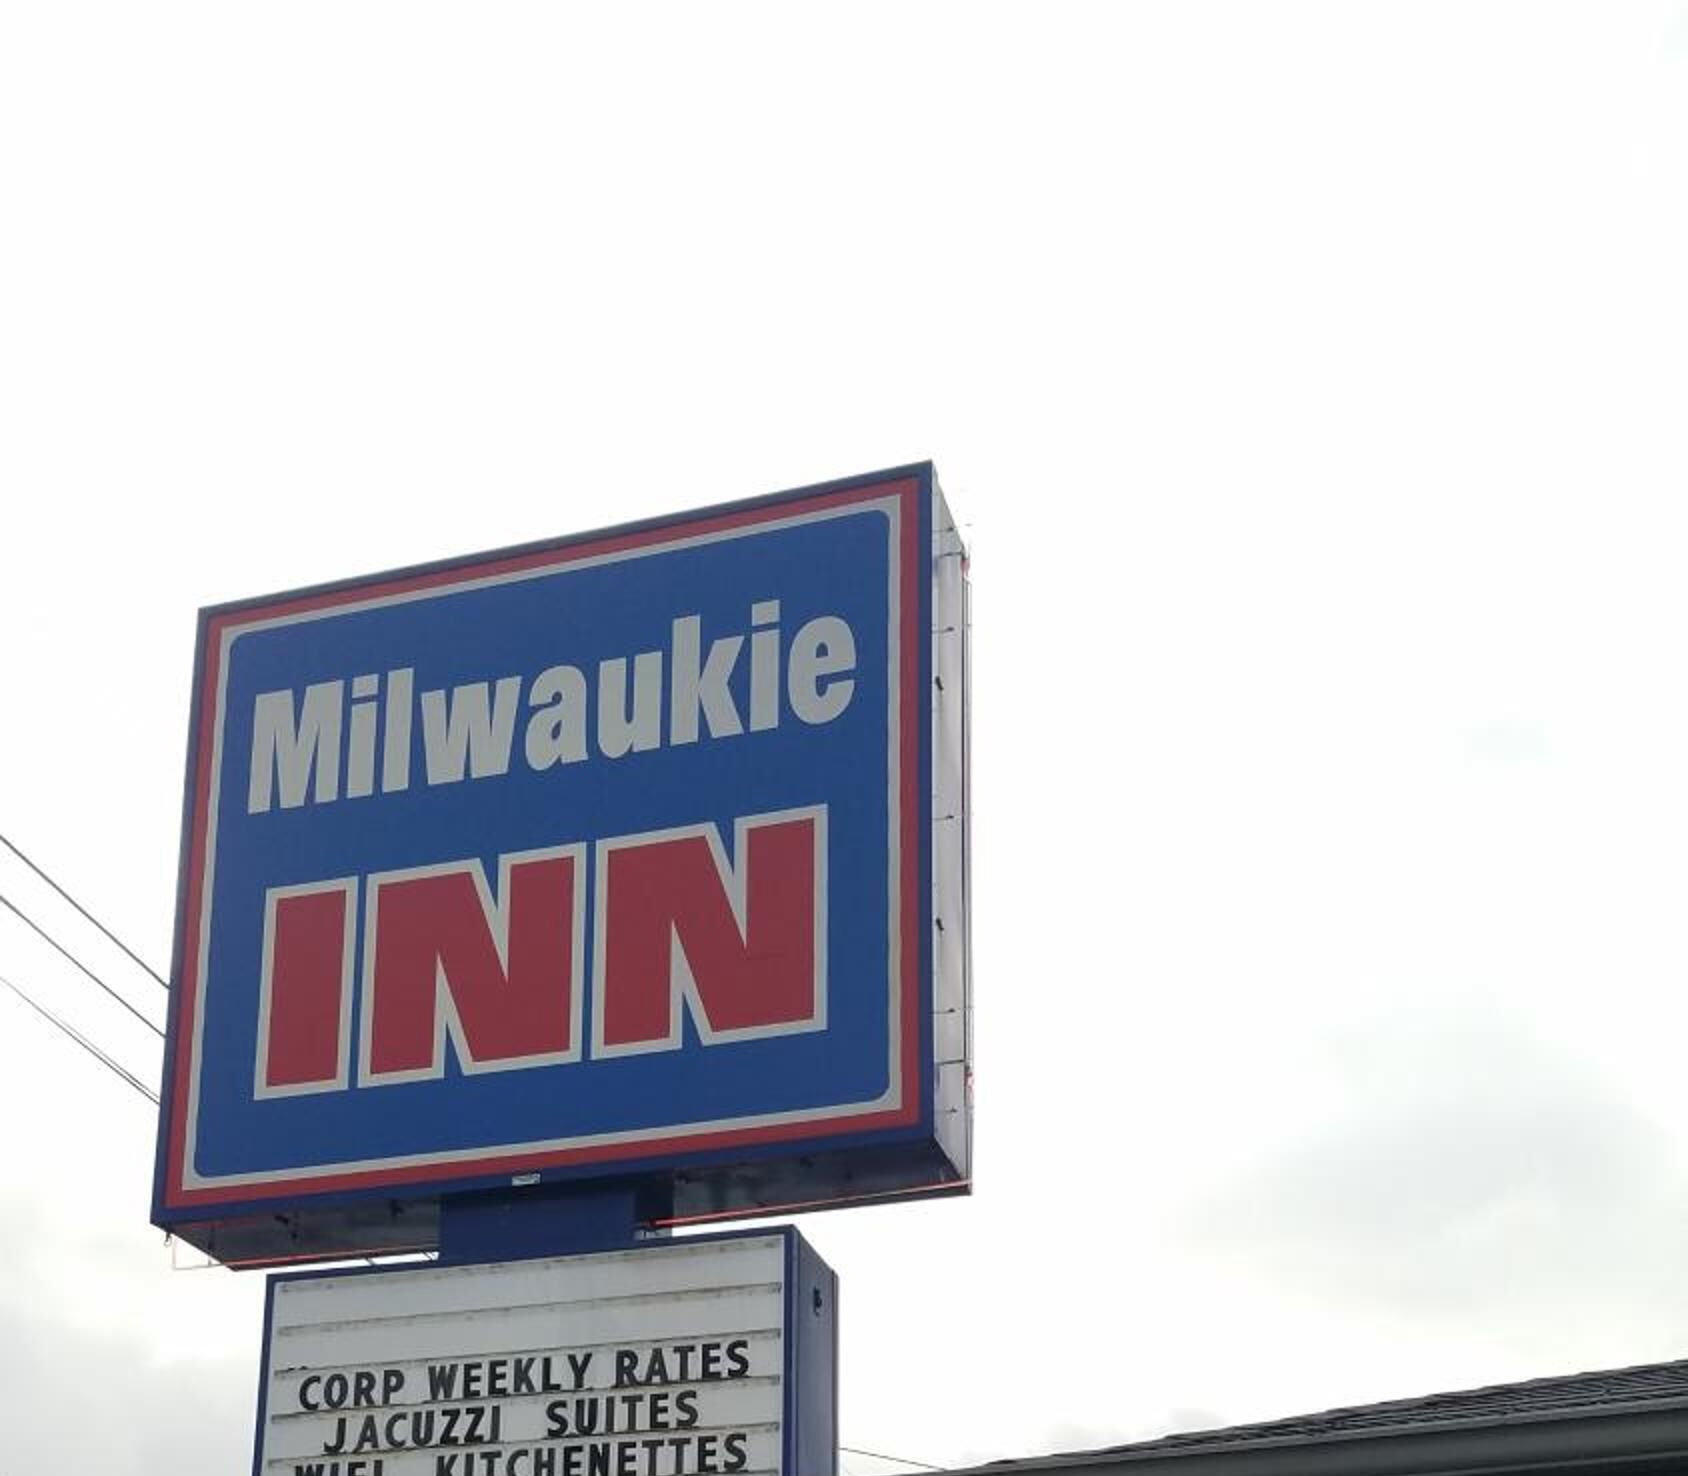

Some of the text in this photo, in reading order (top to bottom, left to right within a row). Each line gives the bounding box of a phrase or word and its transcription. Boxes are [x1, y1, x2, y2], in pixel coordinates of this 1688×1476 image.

[248, 600, 857, 814] Milwaukie
[253, 803, 829, 1101] INN
[298, 1340, 750, 1412] CORP WEEKLY RATES
[323, 1390, 699, 1455] JACUZZI SUITES
